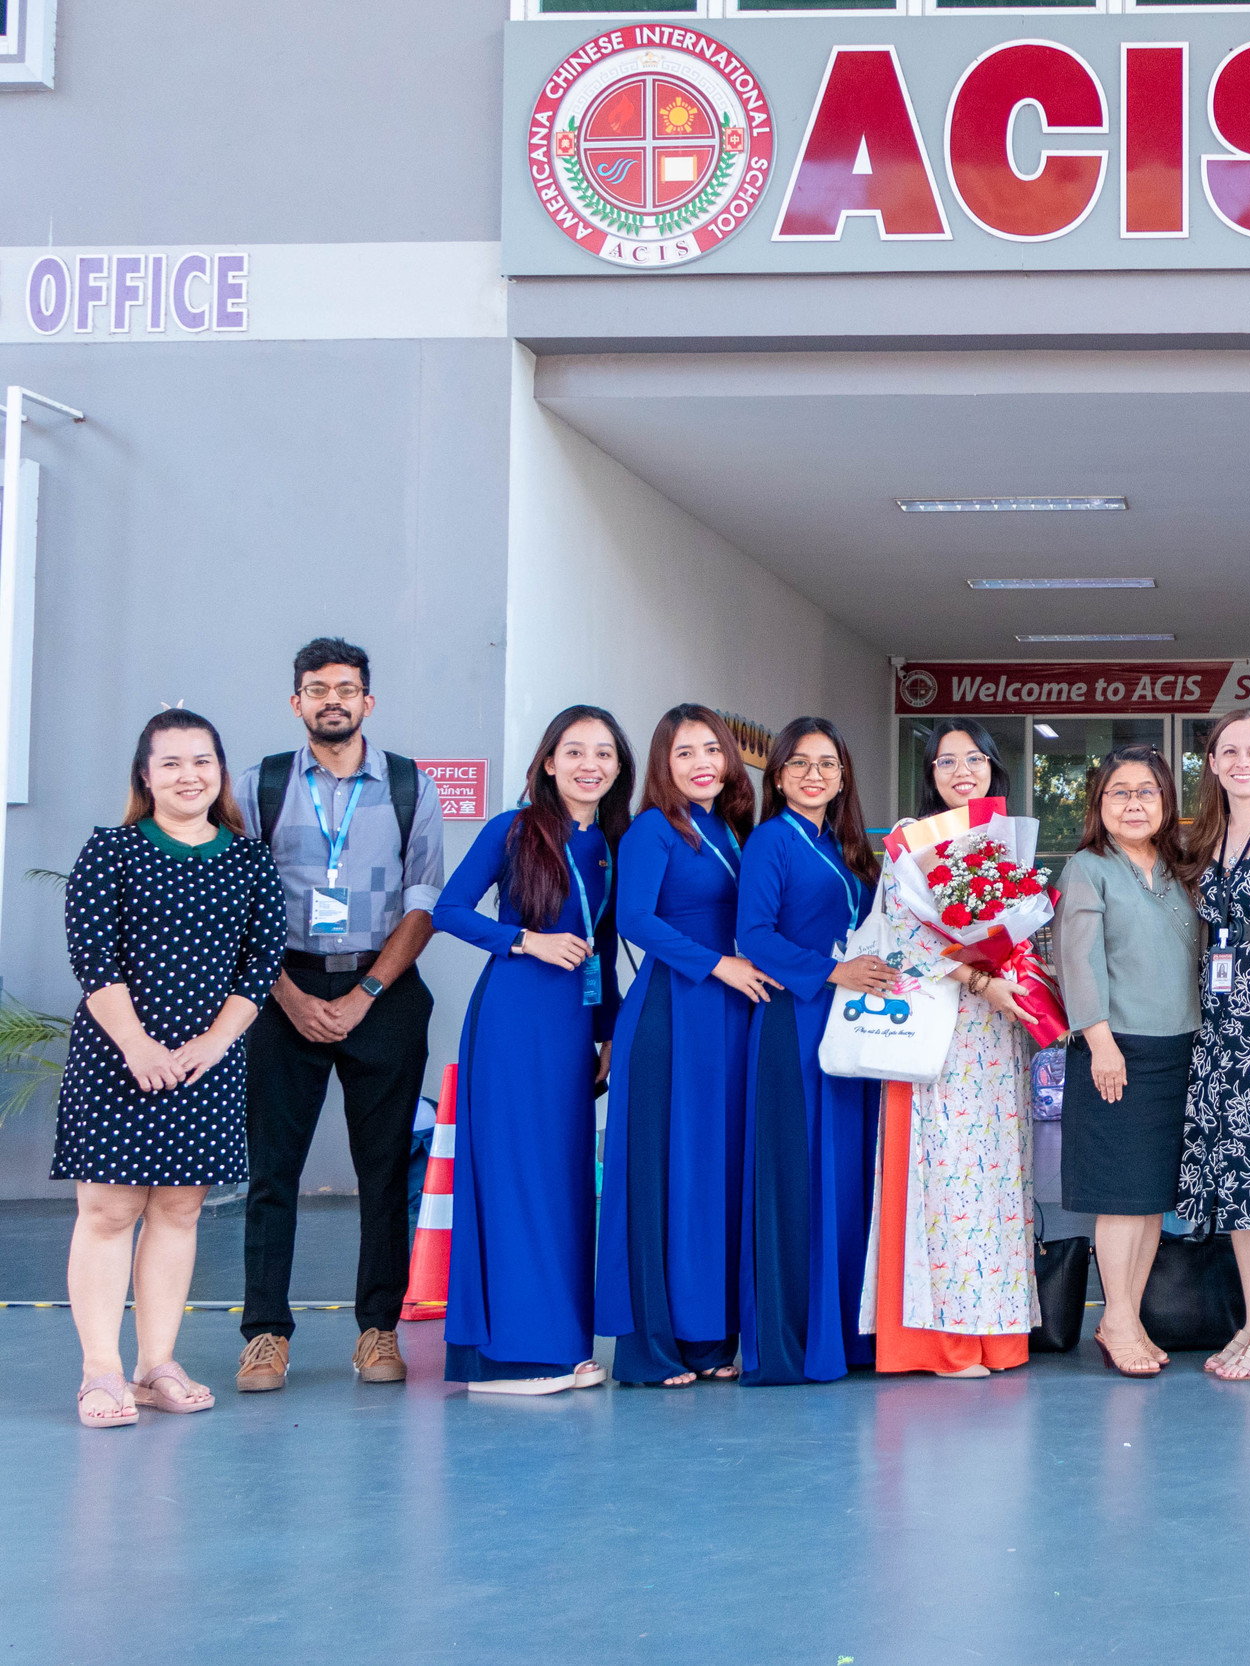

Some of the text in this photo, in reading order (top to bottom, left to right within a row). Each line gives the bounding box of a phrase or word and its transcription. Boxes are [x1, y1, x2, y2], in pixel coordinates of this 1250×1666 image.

[529, 26, 771, 240] AMERICANA CHINESE INTERNATIONAL SCHOOL
[608, 240, 690, 264] ACIS
[25, 252, 249, 336] OFFICE
[951, 675, 1087, 702] Welcome
[1094, 677, 1126, 702] to
[1131, 675, 1202, 701] ACIS
[425, 767, 477, 778] OFFICE
[441, 800, 476, 814] 公室
